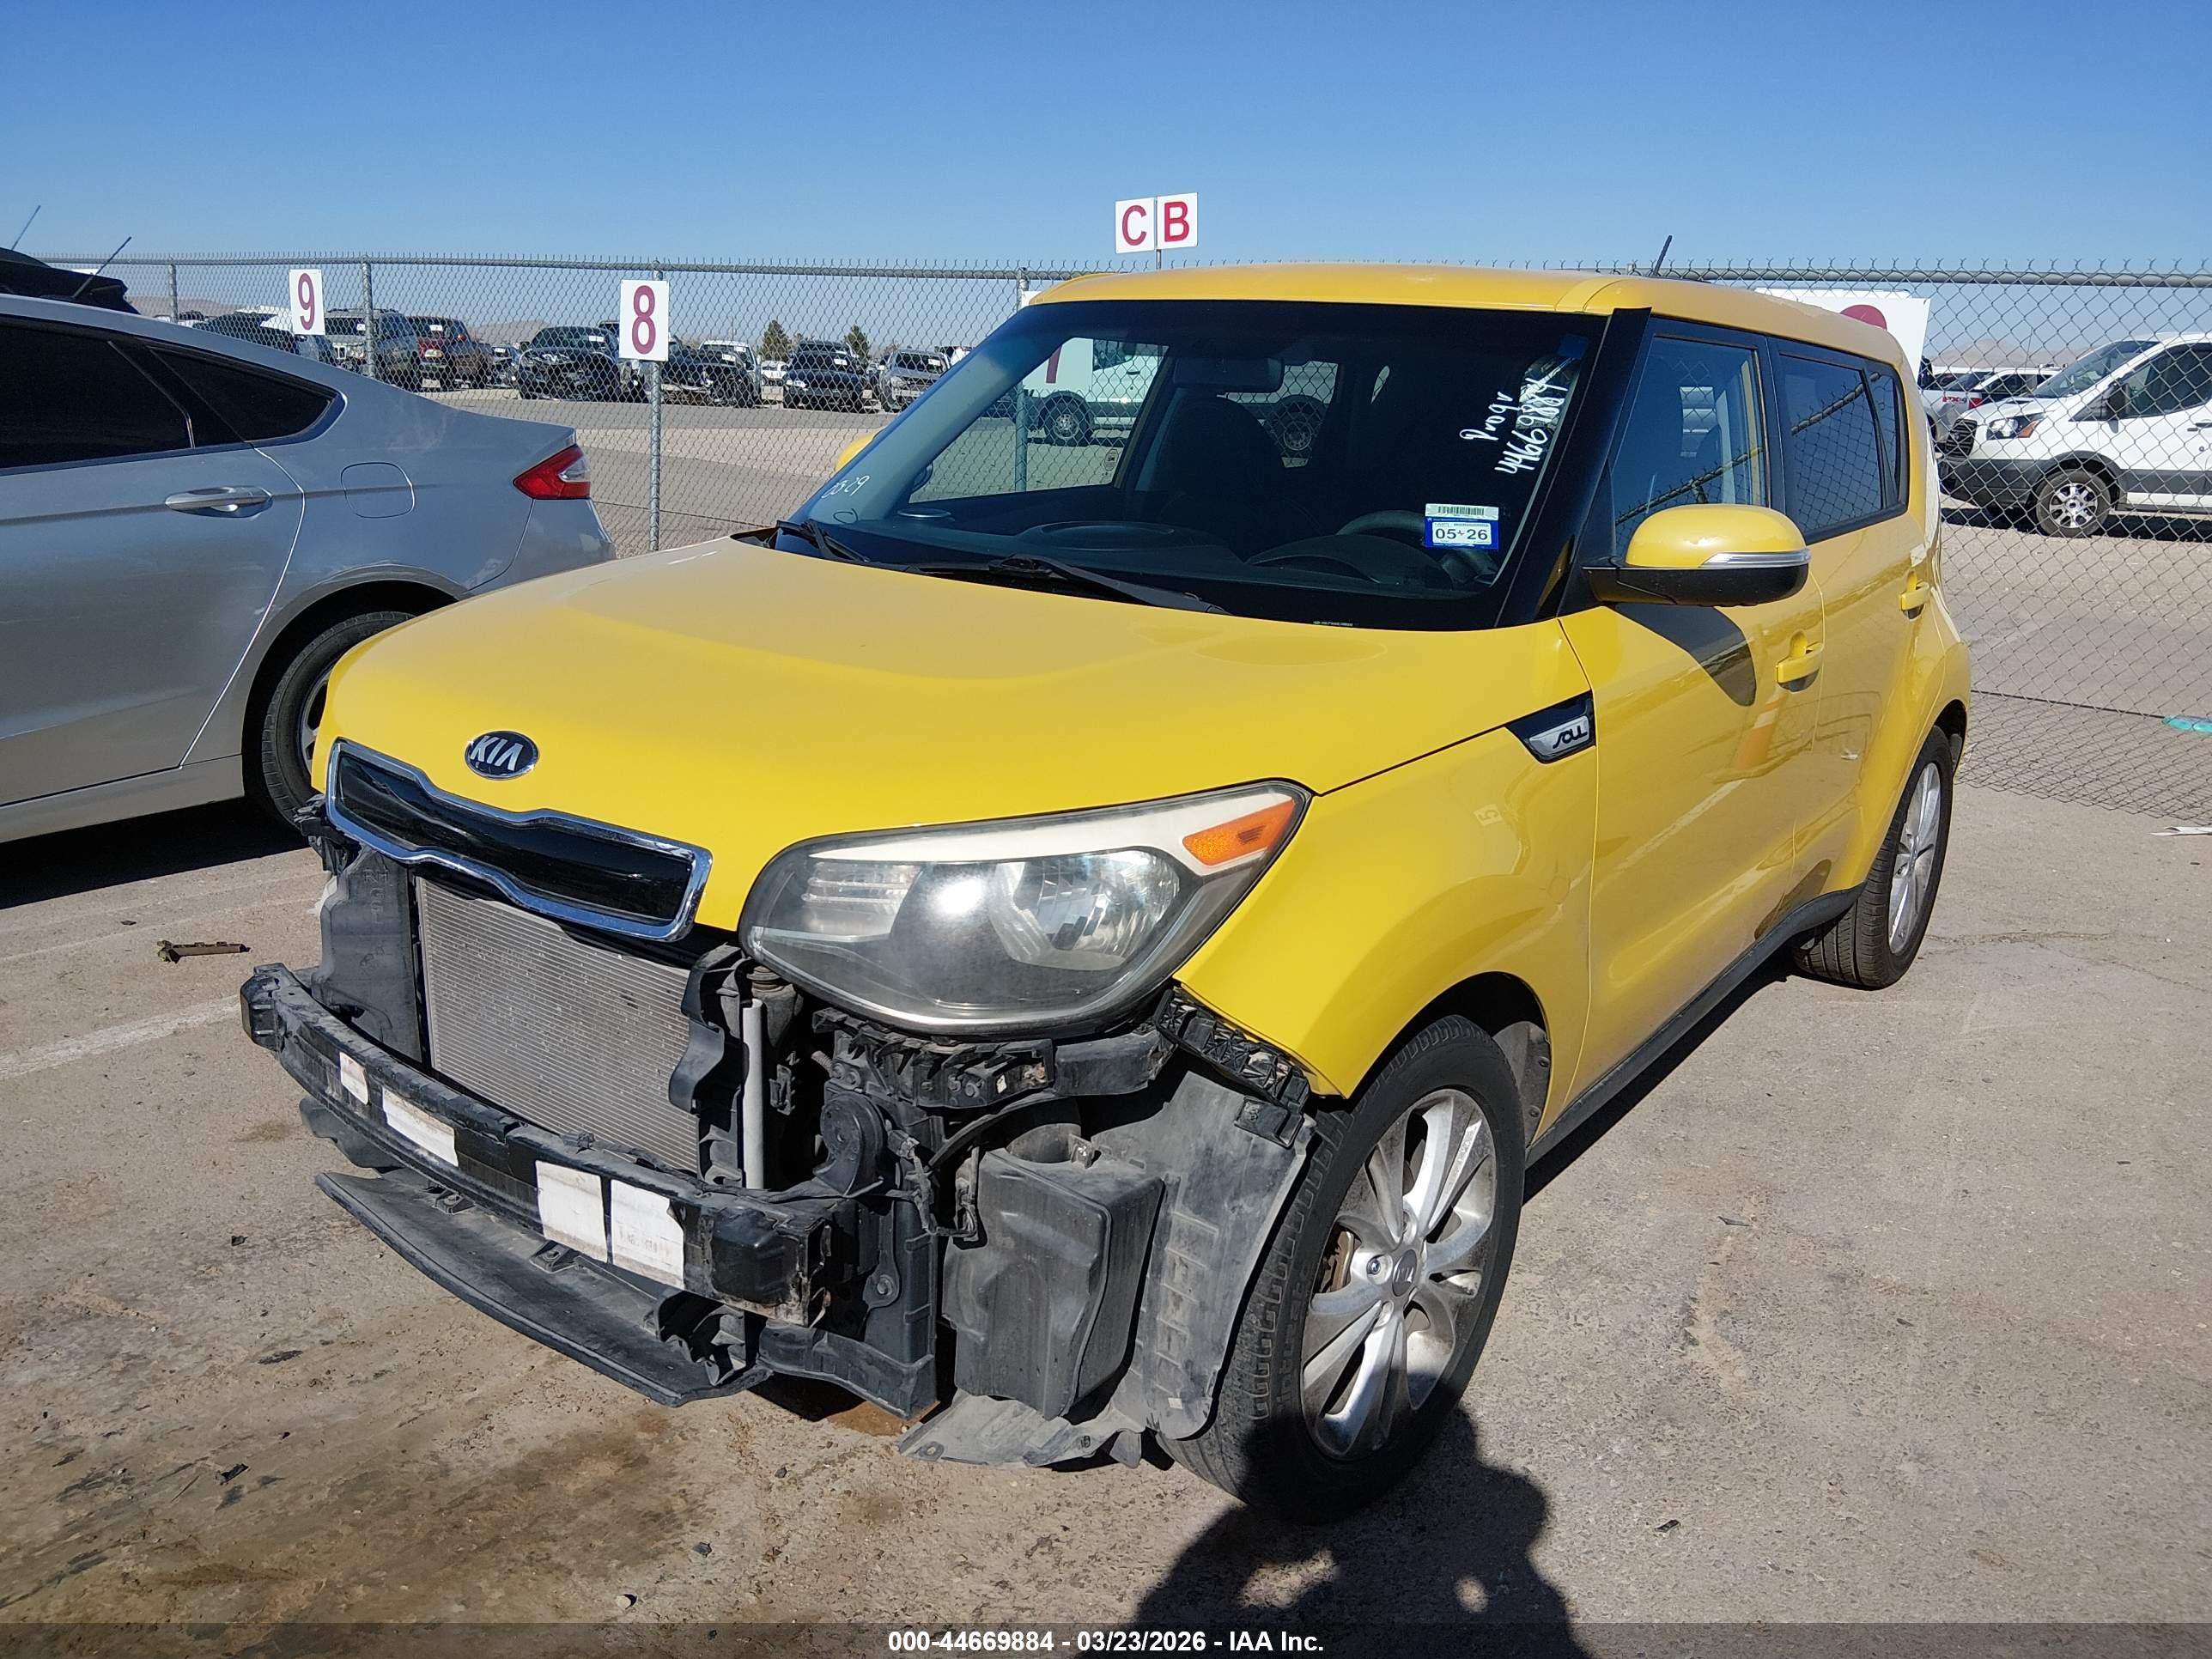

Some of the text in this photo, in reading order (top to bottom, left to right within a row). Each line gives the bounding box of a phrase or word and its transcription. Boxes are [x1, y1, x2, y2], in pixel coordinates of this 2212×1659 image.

[1122, 205, 1147, 246] C
[1164, 202, 1190, 242] B
[298, 273, 315, 331] 9
[632, 285, 656, 355] 8
[1494, 378, 1569, 474] 44669884
[1435, 528, 1489, 541] 05 26
[470, 735, 524, 771] KIA
